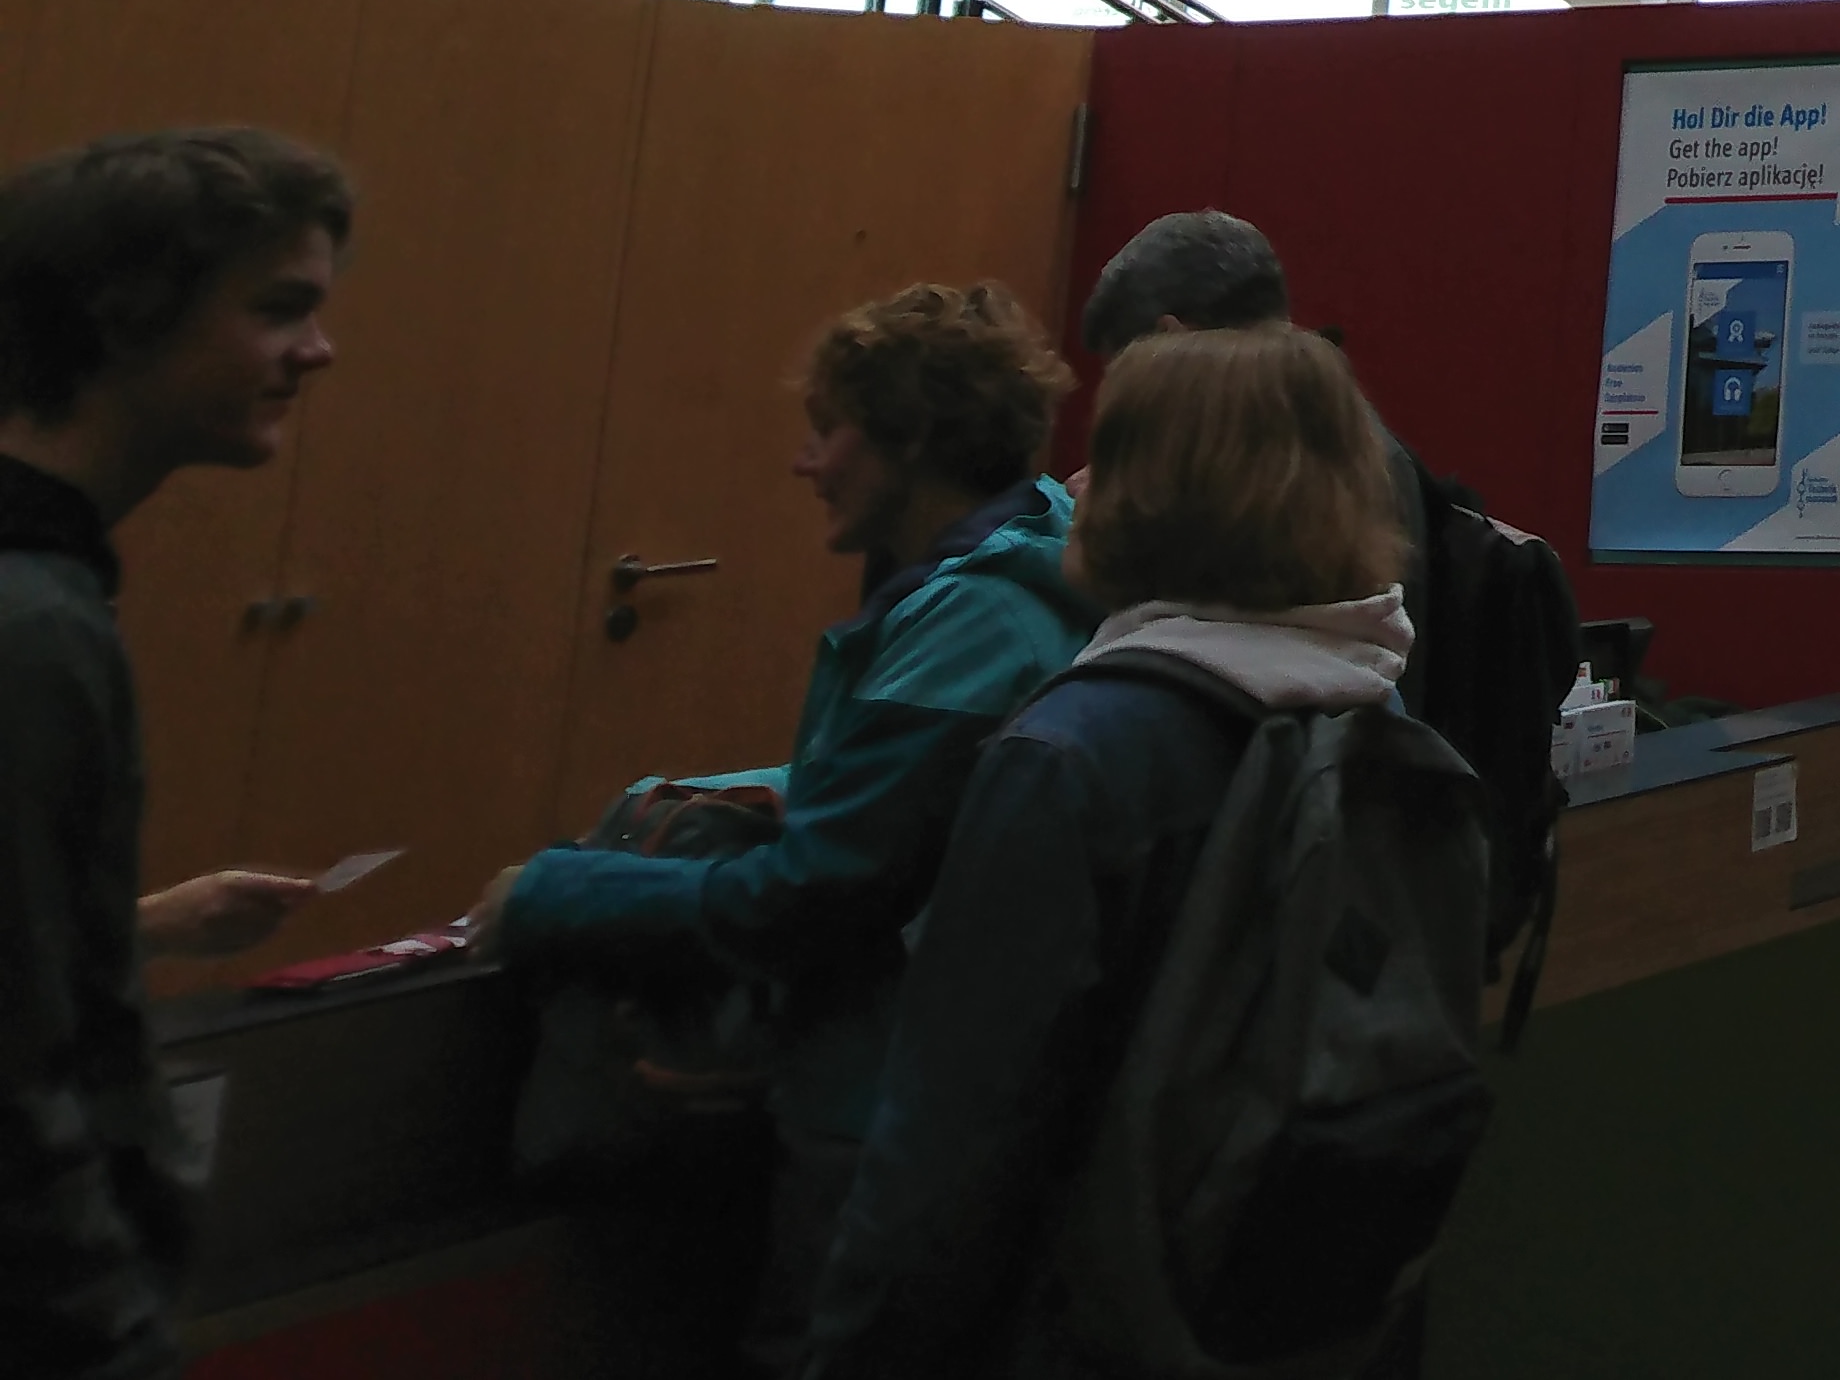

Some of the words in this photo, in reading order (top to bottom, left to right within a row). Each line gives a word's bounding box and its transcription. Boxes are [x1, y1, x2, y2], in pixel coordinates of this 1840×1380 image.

[1672, 107, 1705, 130] Hol
[1711, 106, 1740, 129] Dir
[1744, 104, 1774, 127] die
[1780, 102, 1828, 131] App!
[1669, 139, 1701, 159] Get
[1705, 138, 1733, 158] the
[1737, 136, 1780, 162] app!
[1666, 165, 1732, 188] Pobierz
[1737, 163, 1825, 190] aplikację!
